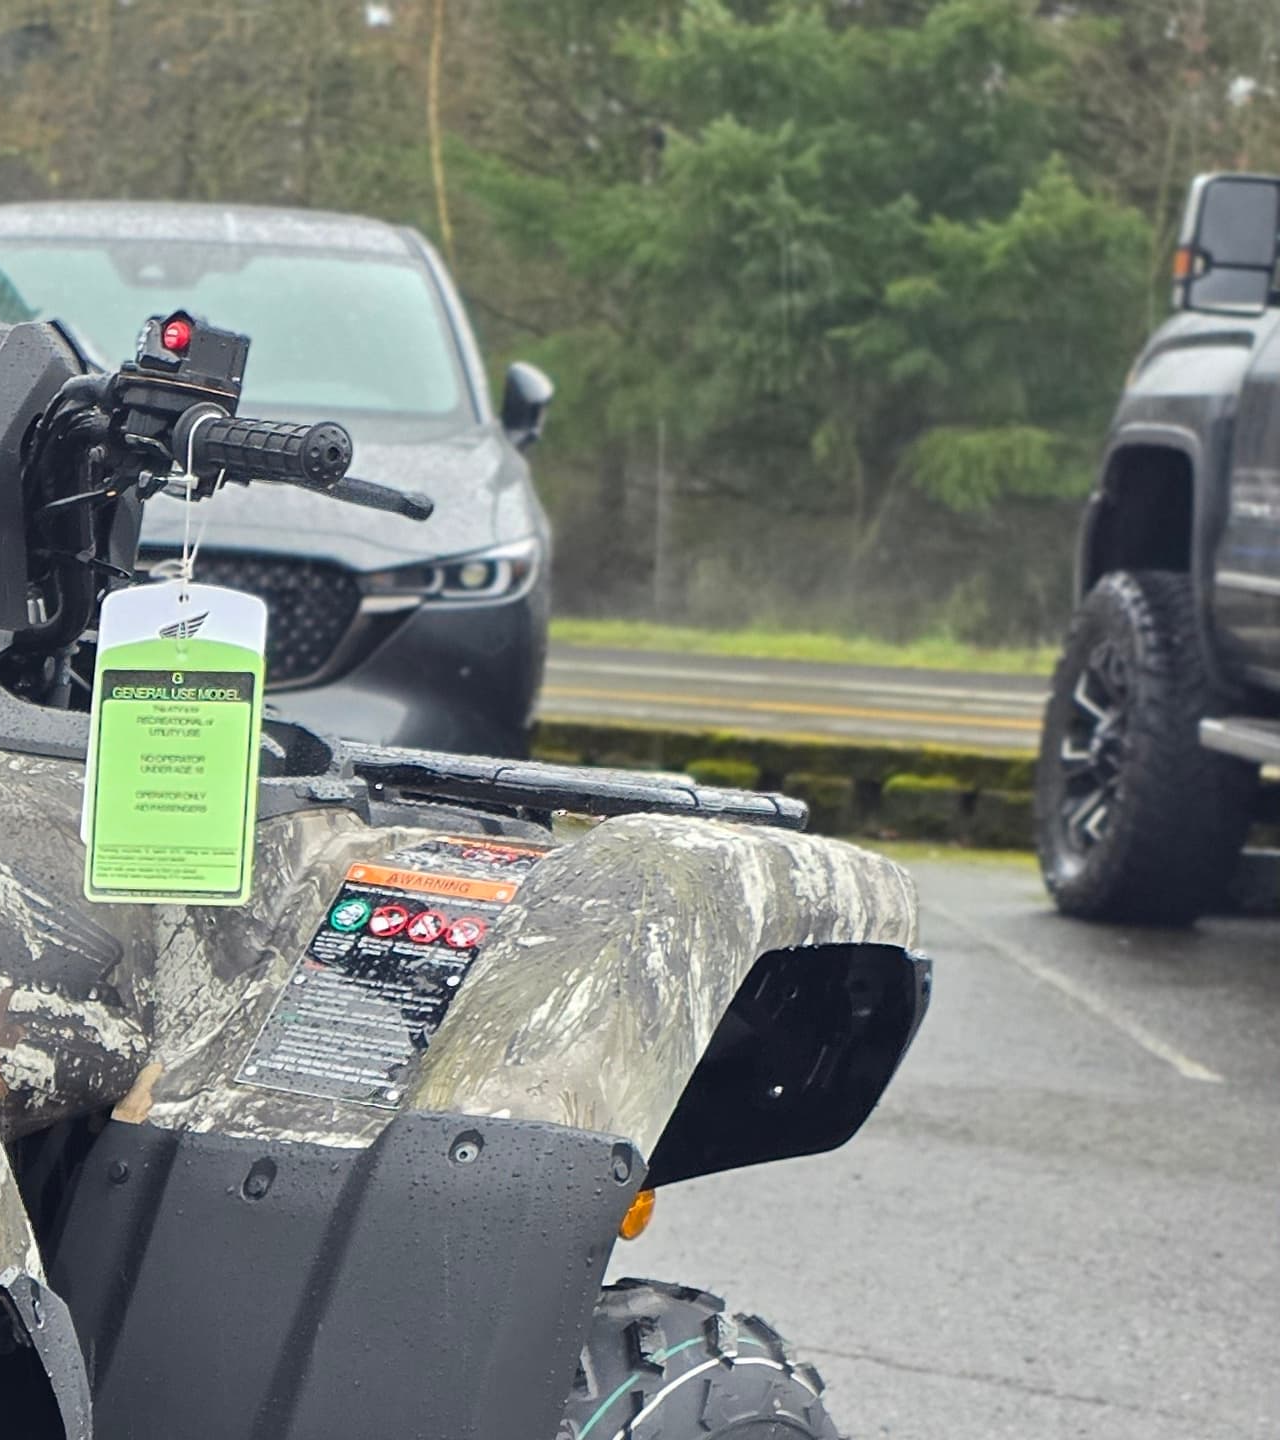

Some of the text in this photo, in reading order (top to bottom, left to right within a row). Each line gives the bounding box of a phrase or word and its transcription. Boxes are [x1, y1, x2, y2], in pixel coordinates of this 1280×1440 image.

[112, 686, 241, 701] GENERAL USE MODEL
[397, 872, 472, 895] WARNING
